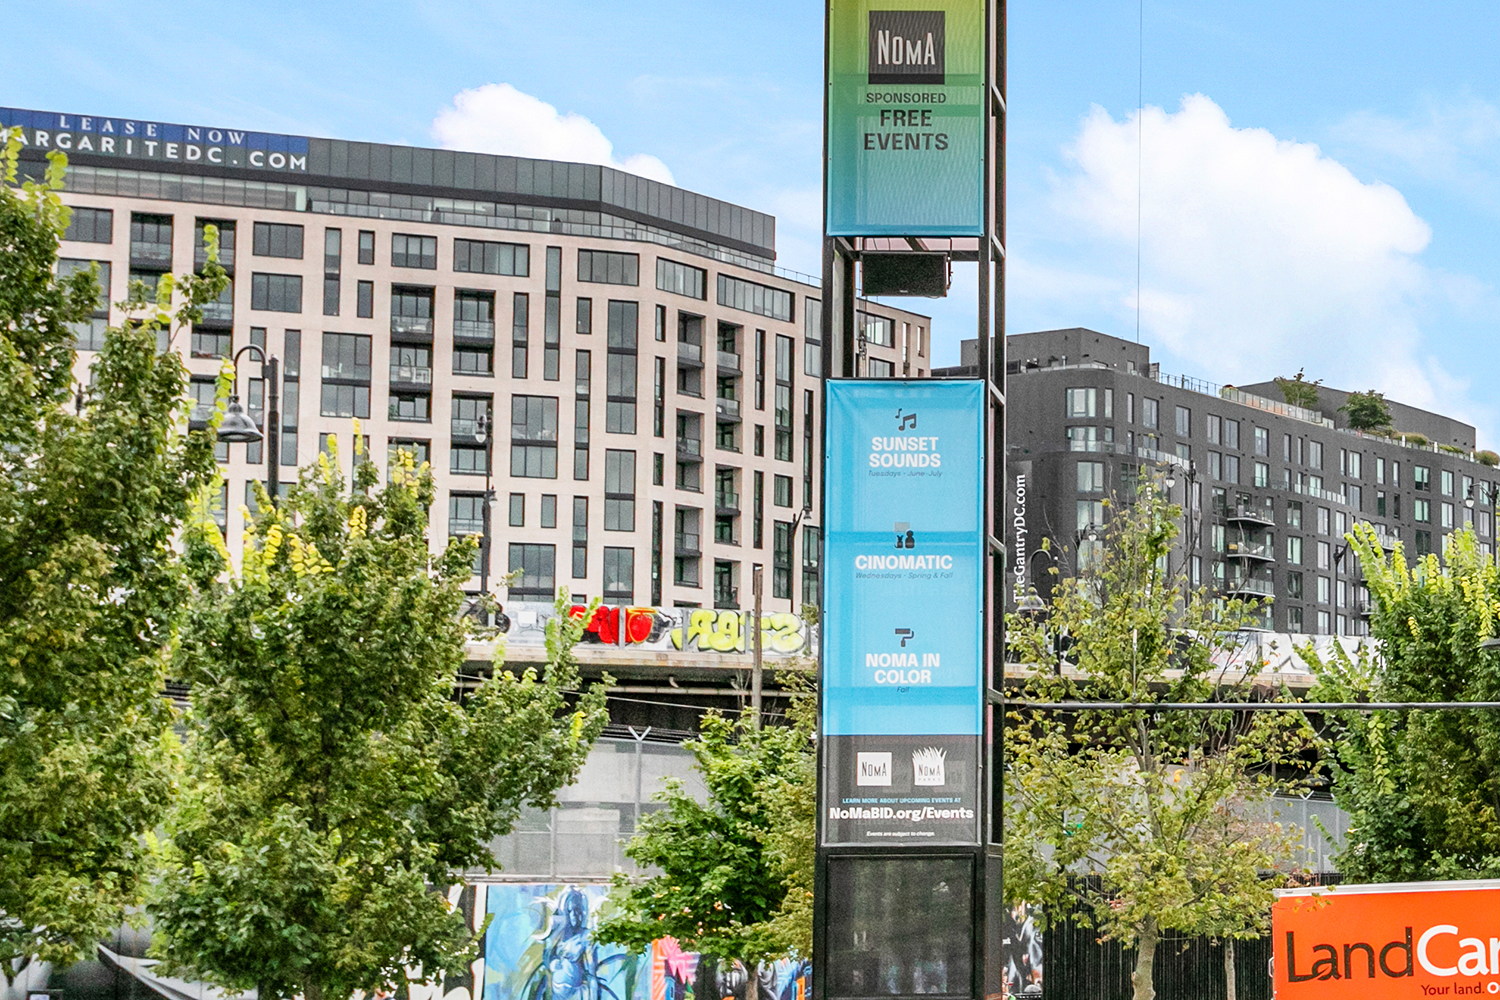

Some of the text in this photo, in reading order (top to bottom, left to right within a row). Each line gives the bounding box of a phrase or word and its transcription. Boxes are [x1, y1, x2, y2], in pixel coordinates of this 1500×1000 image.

[866, 92, 947, 104] SPONSORED
[880, 109, 932, 127] FREE
[59, 113, 246, 146] LEASE NOW
[864, 132, 949, 151] EVENTS
[871, 436, 939, 451] SUNSET
[869, 453, 941, 468] SOUNDS
[1013, 474, 1028, 603] TeGantryDC.com
[854, 555, 953, 570] CINOMATIC
[855, 572, 902, 580] Wednesdays
[908, 572, 932, 580] Spring
[865, 653, 940, 668] NOMA IN
[874, 669, 932, 684] COLOR
[829, 807, 975, 822] NoMaBID.org/Events
[1421, 984, 1450, 996] Your
[1454, 982, 1485, 995] land.
